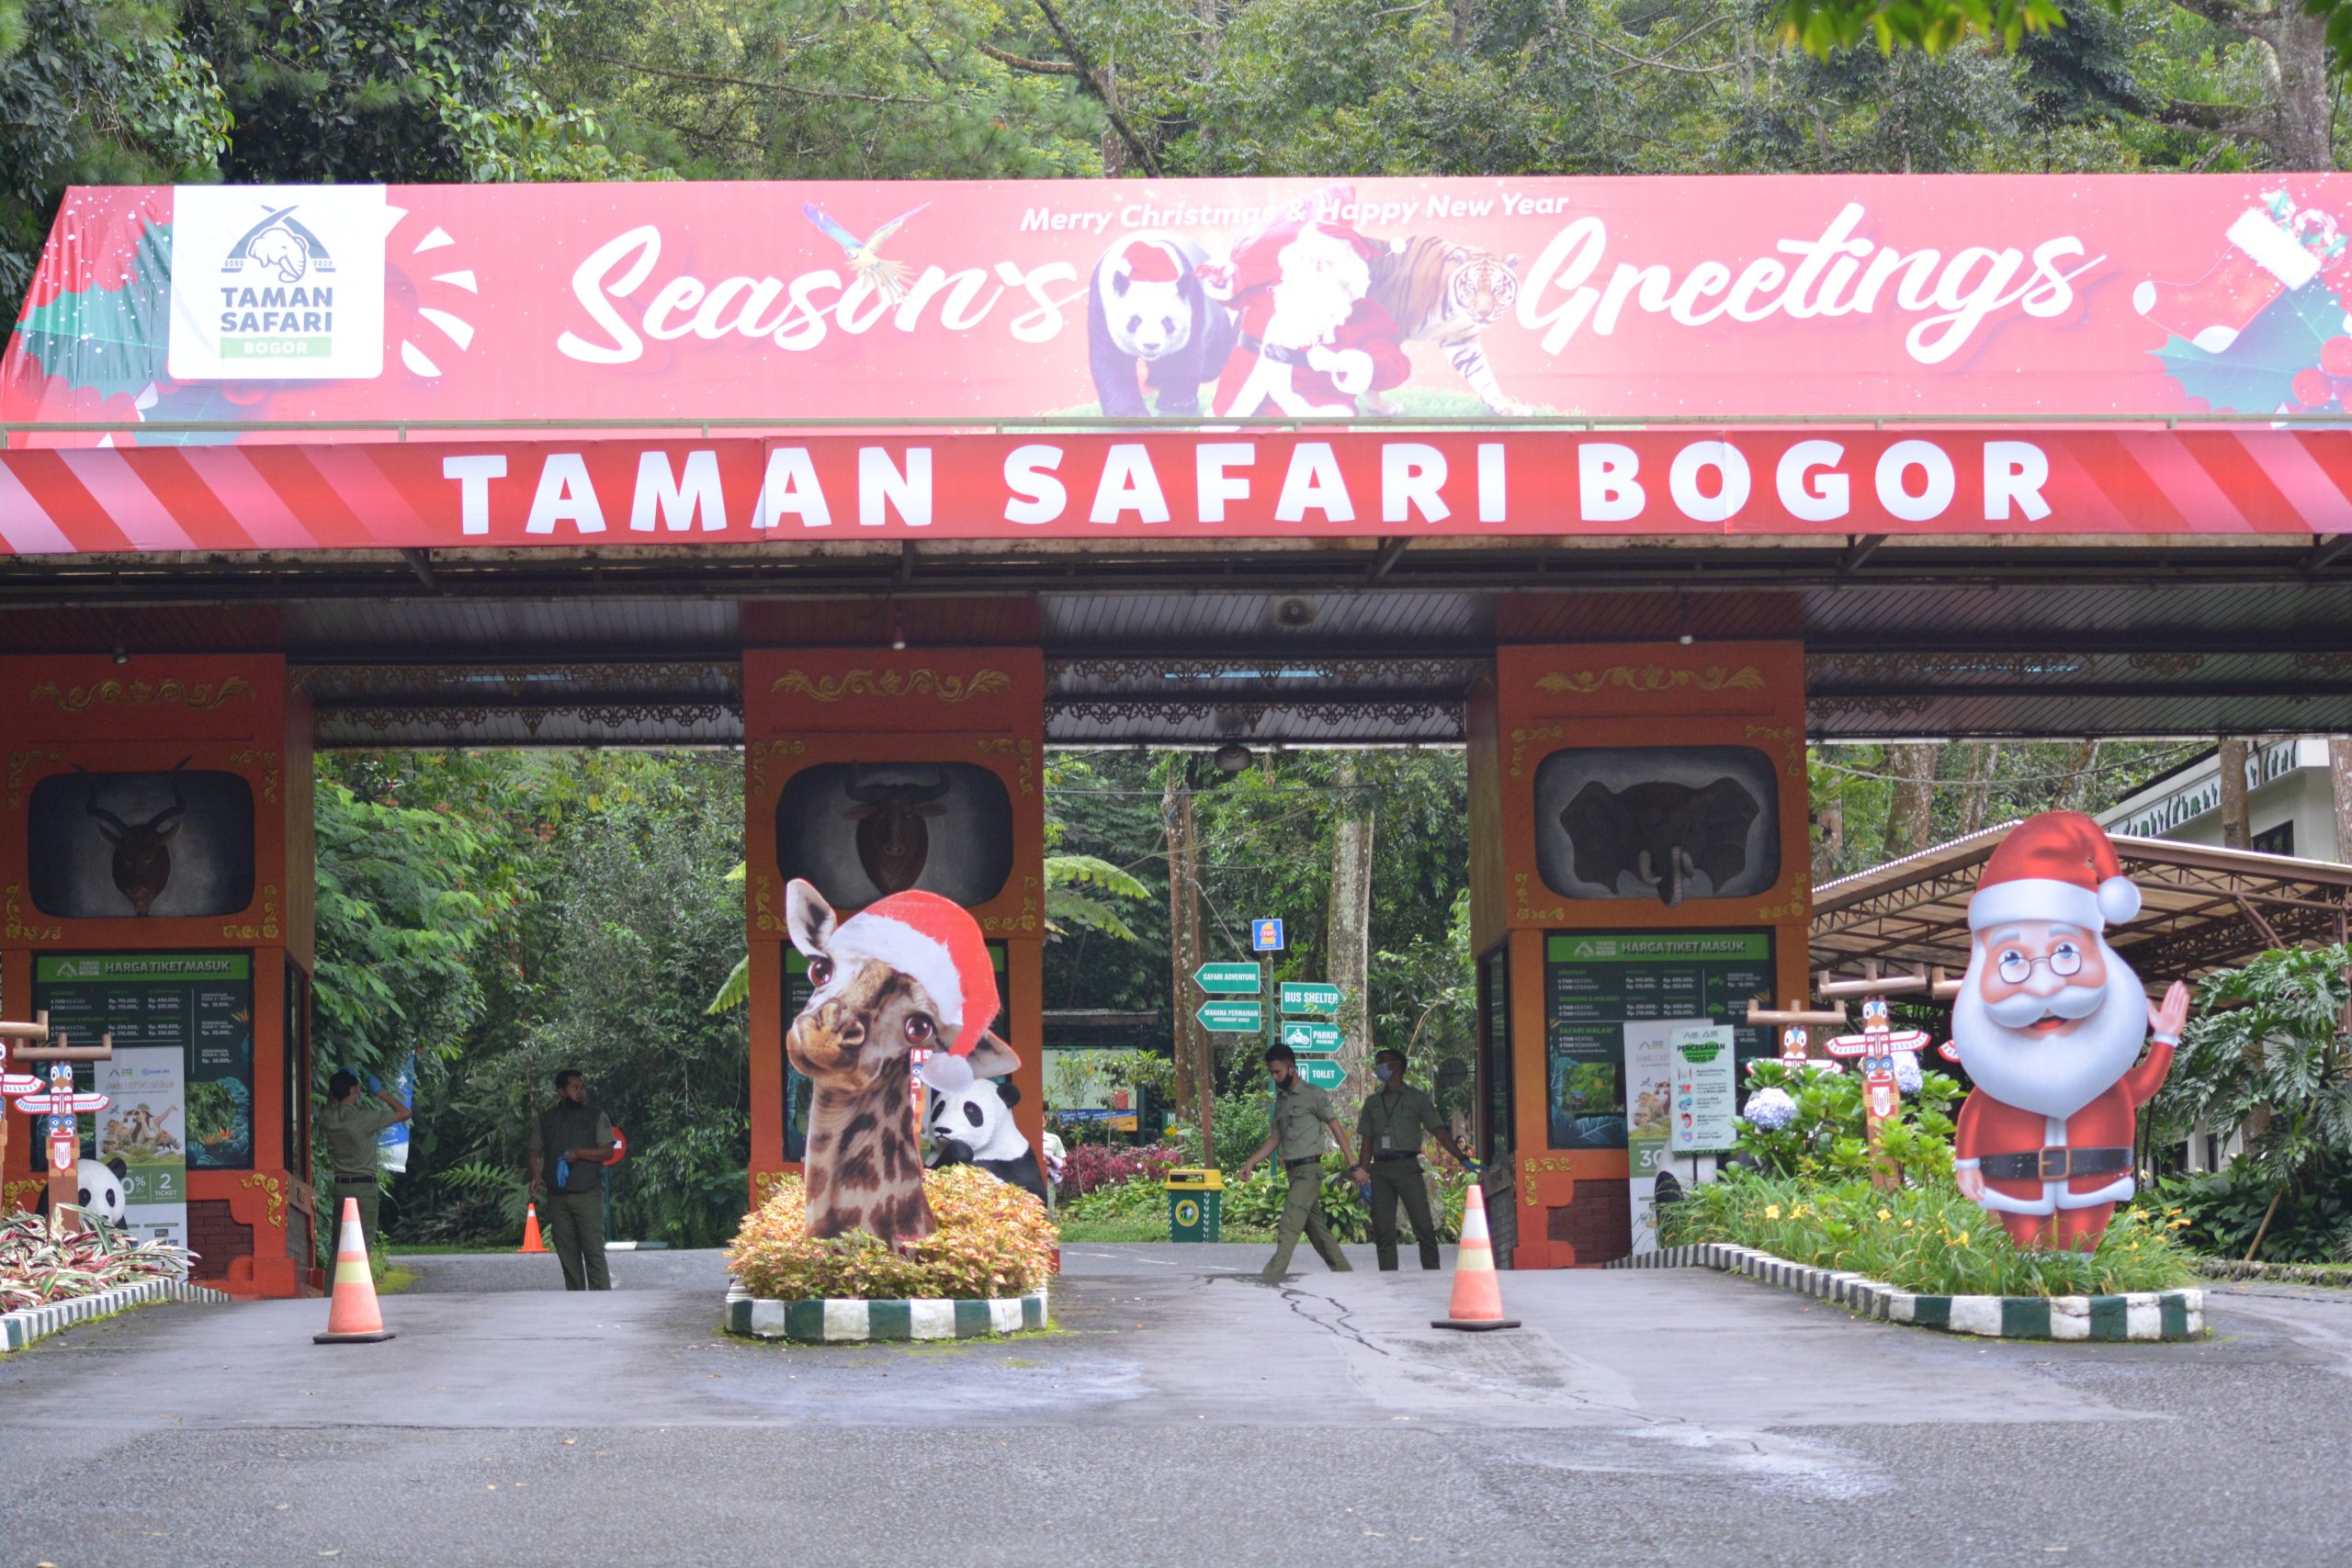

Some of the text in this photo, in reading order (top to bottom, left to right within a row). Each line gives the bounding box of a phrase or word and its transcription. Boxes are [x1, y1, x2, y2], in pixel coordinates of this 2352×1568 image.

[1020, 192, 1569, 235] Merry Christmas & Happy New Year
[557, 202, 2107, 365] Season's Greetings
[220, 287, 334, 309] TAMAN
[220, 311, 333, 333] SAFARI
[243, 341, 308, 355] BOGOR
[443, 440, 2052, 536] TAMAN SAFARI BOGOR
[1622, 942, 1663, 953] HARGA
[1667, 942, 1699, 953] TIKET
[1701, 941, 1745, 952] MASUK
[106, 960, 230, 973] HARGA TIKET MASUK
[1285, 992, 1339, 1003] BUS SHELTER
[1313, 1032, 1338, 1040] PARKIR
[1677, 1043, 1725, 1052] PENCEGAHAN
[1312, 1070, 1335, 1078] TOILET
[160, 1173, 171, 1190] 2
